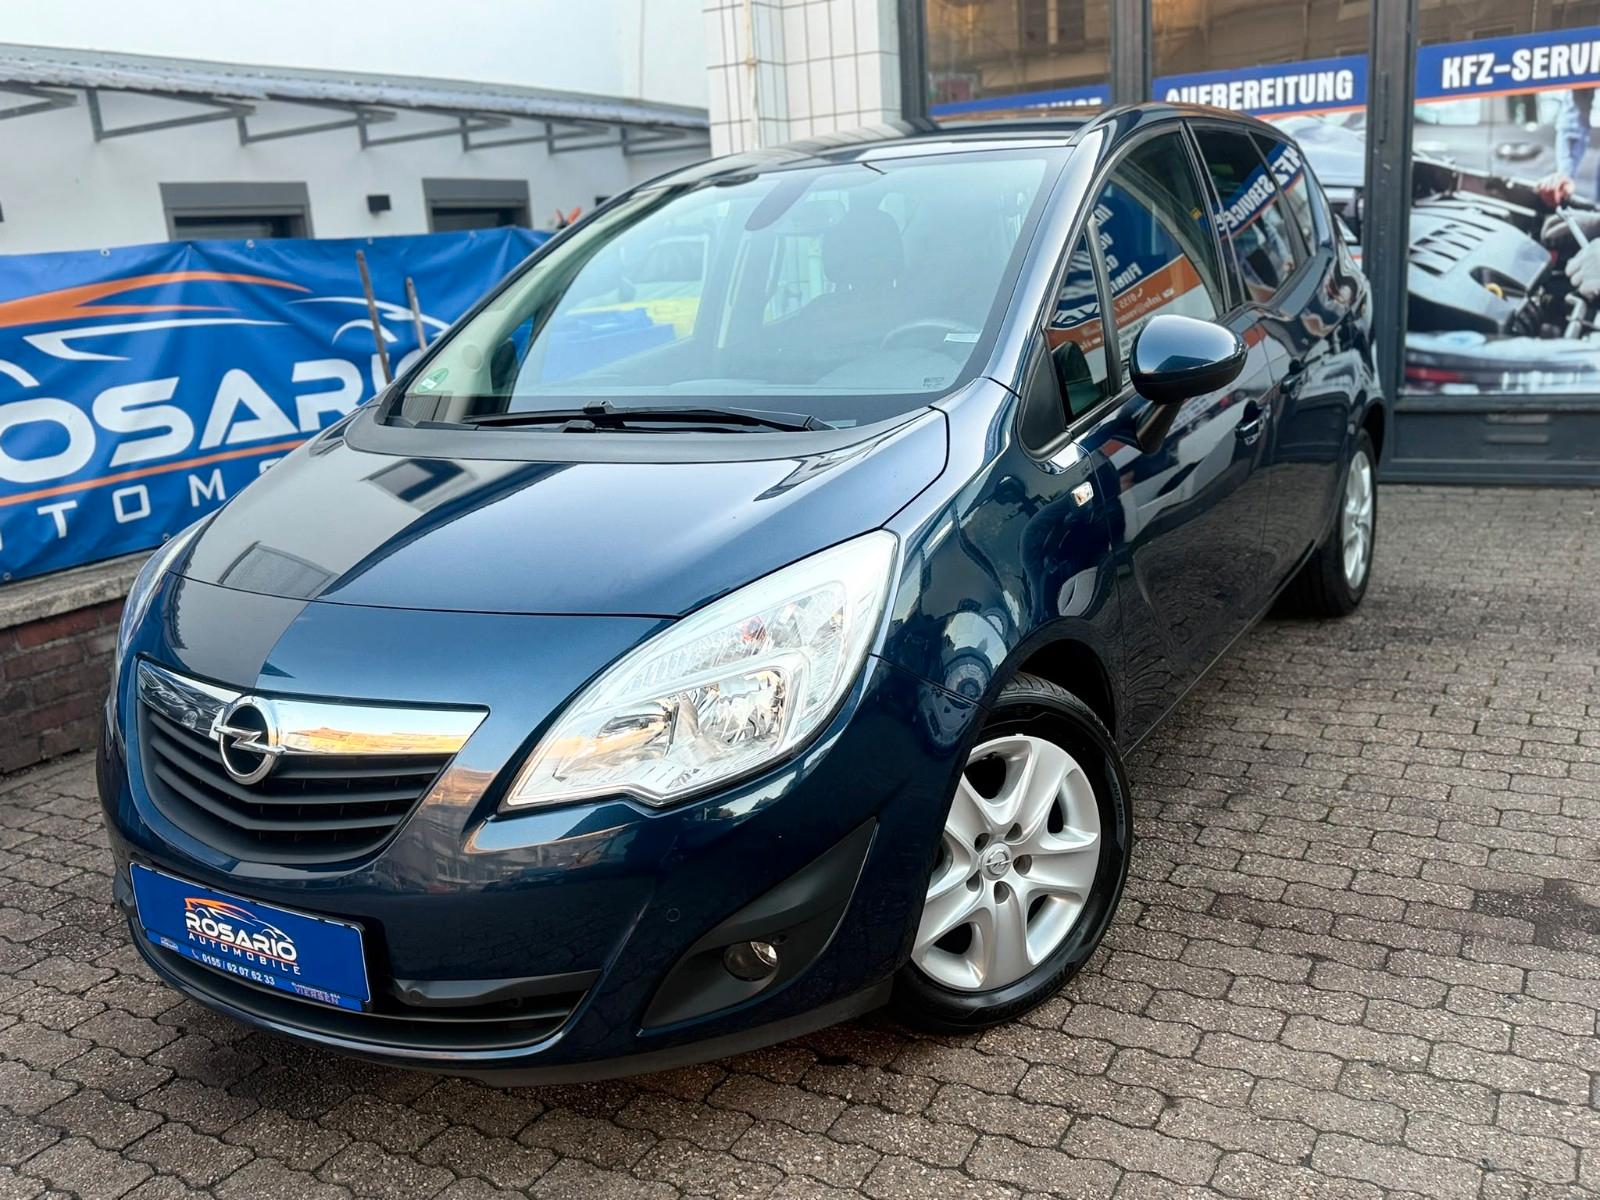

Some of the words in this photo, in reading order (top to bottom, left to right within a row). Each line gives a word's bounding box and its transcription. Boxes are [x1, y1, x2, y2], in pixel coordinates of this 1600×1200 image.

[185, 911, 297, 961] ROSARIO
[189, 932, 301, 975] AUTOMOBILE
[202, 953, 221, 968] 0155
[226, 962, 238, 973] 62
[239, 966, 249, 976] 07
[251, 970, 263, 982] 62
[263, 974, 275, 986] 33
